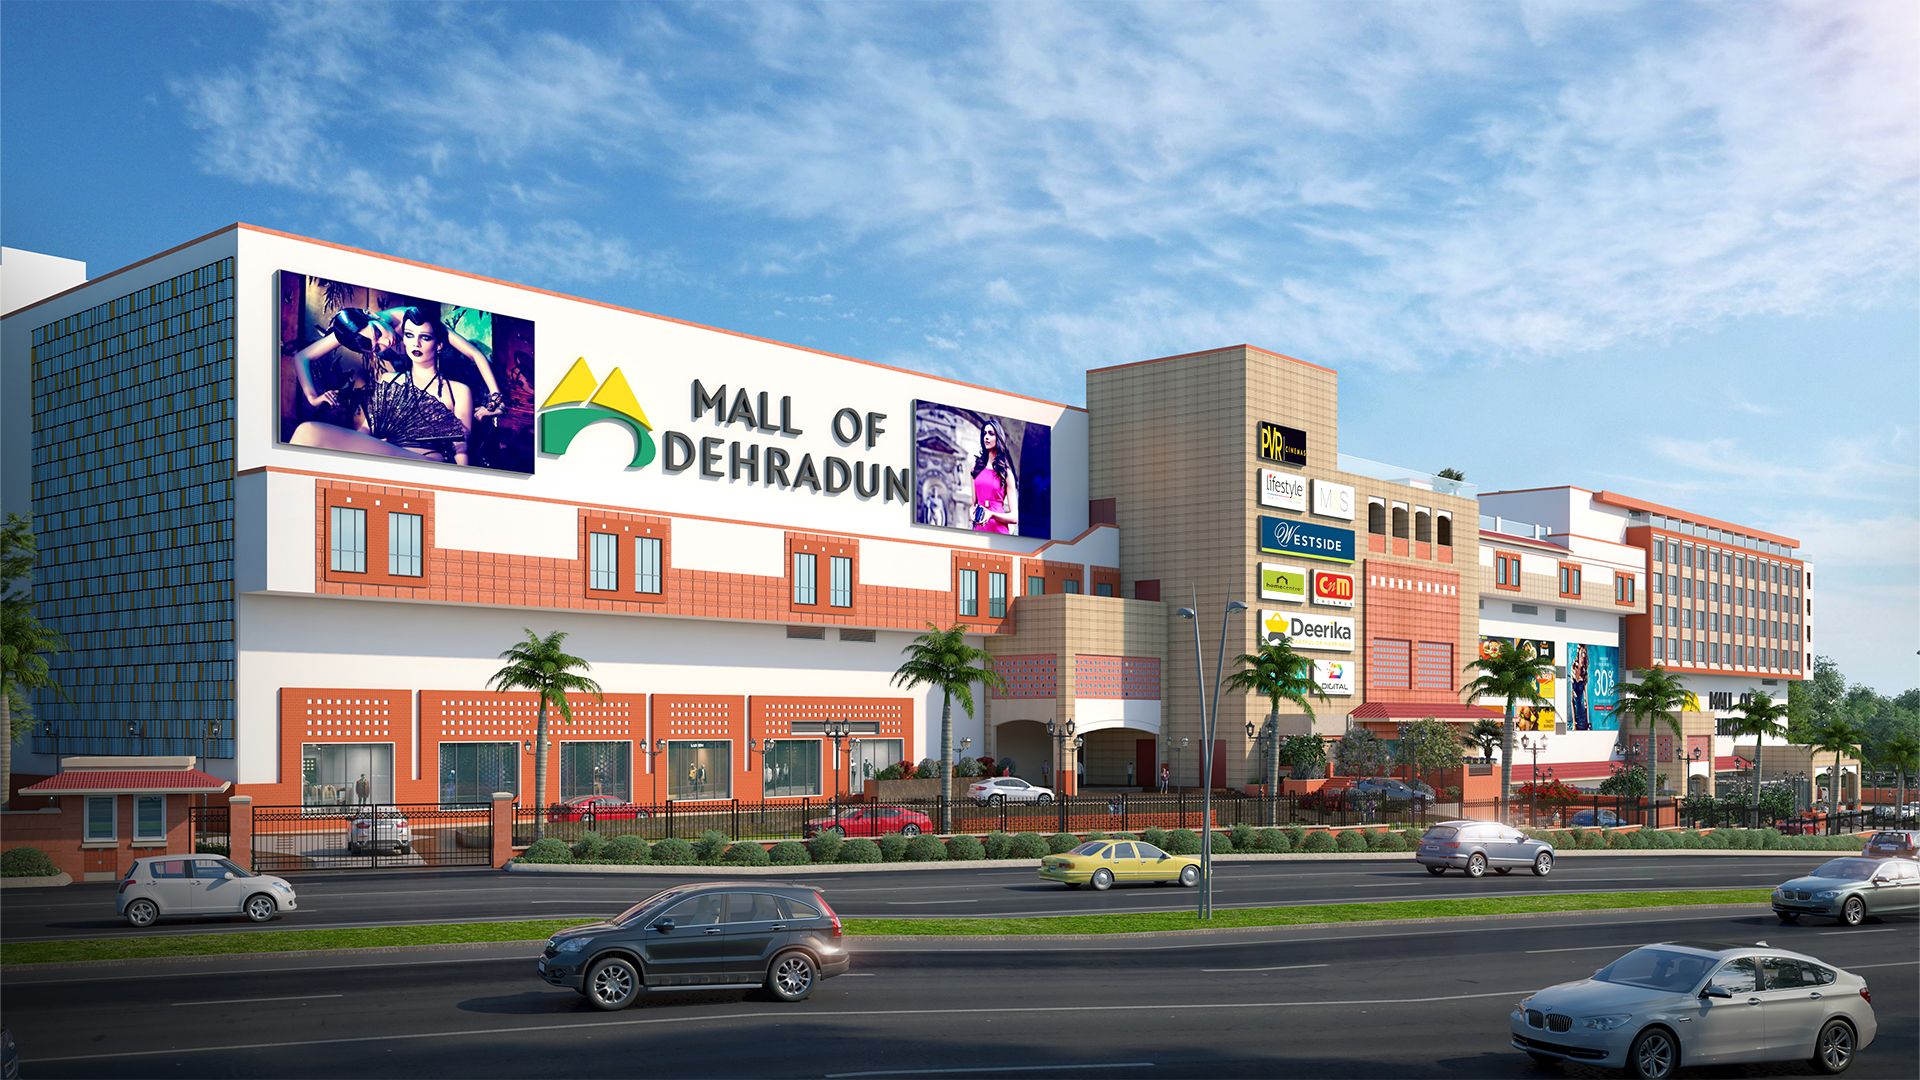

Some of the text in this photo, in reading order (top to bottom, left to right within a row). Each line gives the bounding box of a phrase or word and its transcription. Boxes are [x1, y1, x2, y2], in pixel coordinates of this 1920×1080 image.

[692, 379, 888, 448] MALL OF
[1261, 425, 1307, 461] PVR CINEMAS
[664, 430, 910, 503] DEHRADUN
[1266, 473, 1304, 499] lifestyle
[1320, 487, 1349, 512] MS
[1274, 521, 1342, 552] WESTSIDE
[1291, 617, 1352, 640] Deerika
[1321, 683, 1348, 691] DIGITAL
[1594, 669, 1615, 697] 30%
